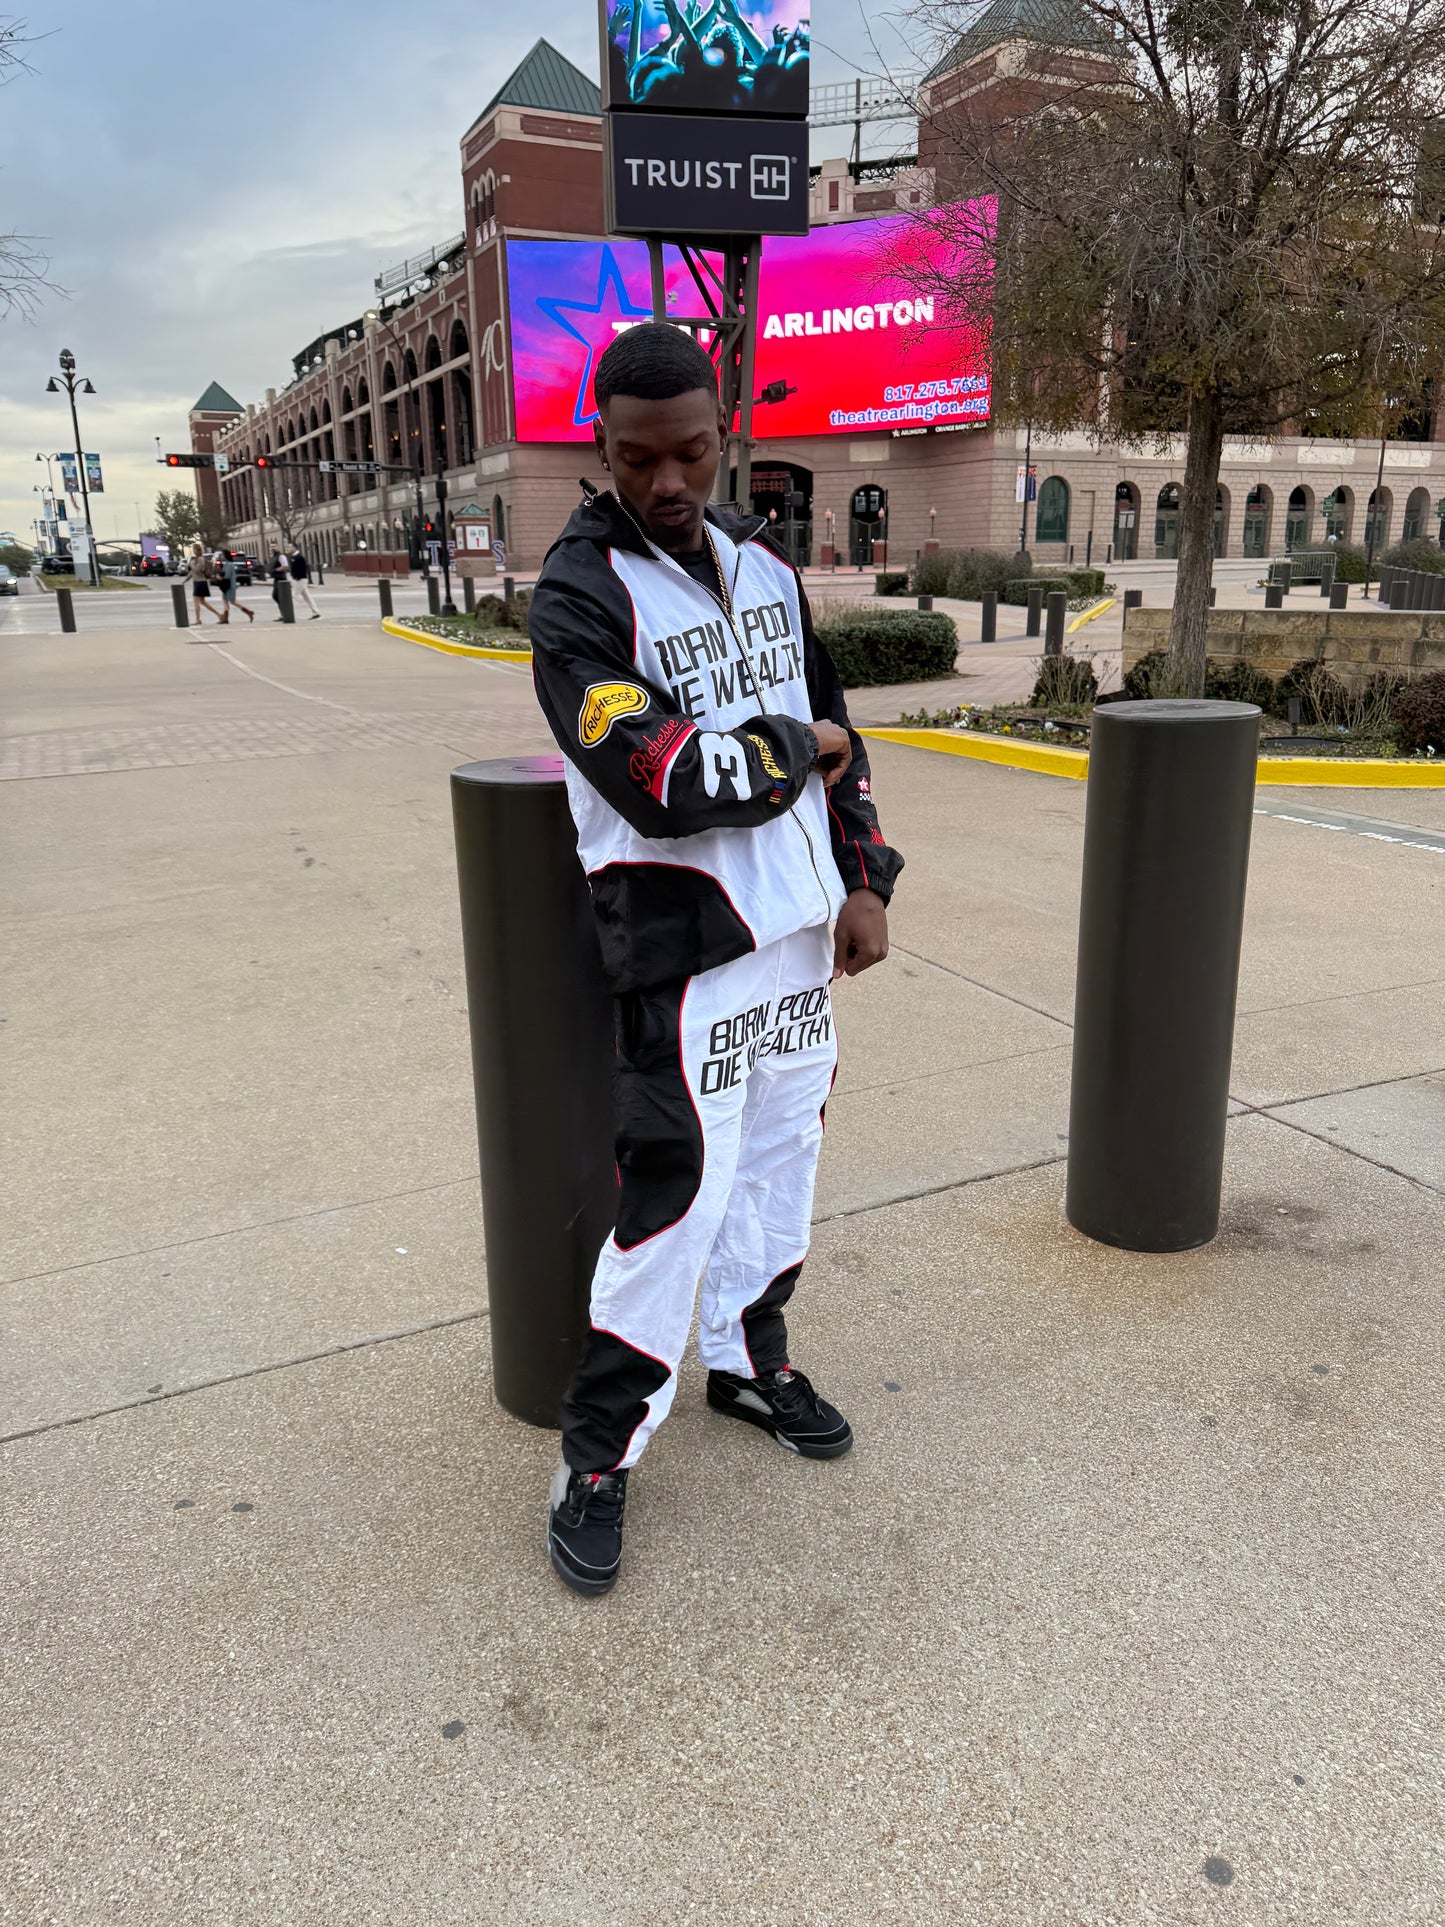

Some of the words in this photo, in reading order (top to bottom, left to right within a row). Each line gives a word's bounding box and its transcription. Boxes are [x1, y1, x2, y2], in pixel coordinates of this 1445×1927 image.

[624, 158, 743, 189] TRUIST
[763, 298, 935, 339] ARLINGTON
[830, 397, 989, 424] theatrearlington.org
[741, 601, 797, 649] POO
[710, 641, 801, 709] WEALTH
[586, 691, 635, 734] RICHESSE
[629, 719, 681, 792] Richesse
[698, 732, 752, 802] 3
[700, 1050, 742, 1096] DIE
[747, 1010, 832, 1072] WEALTHY
[709, 1000, 771, 1056] BORN
